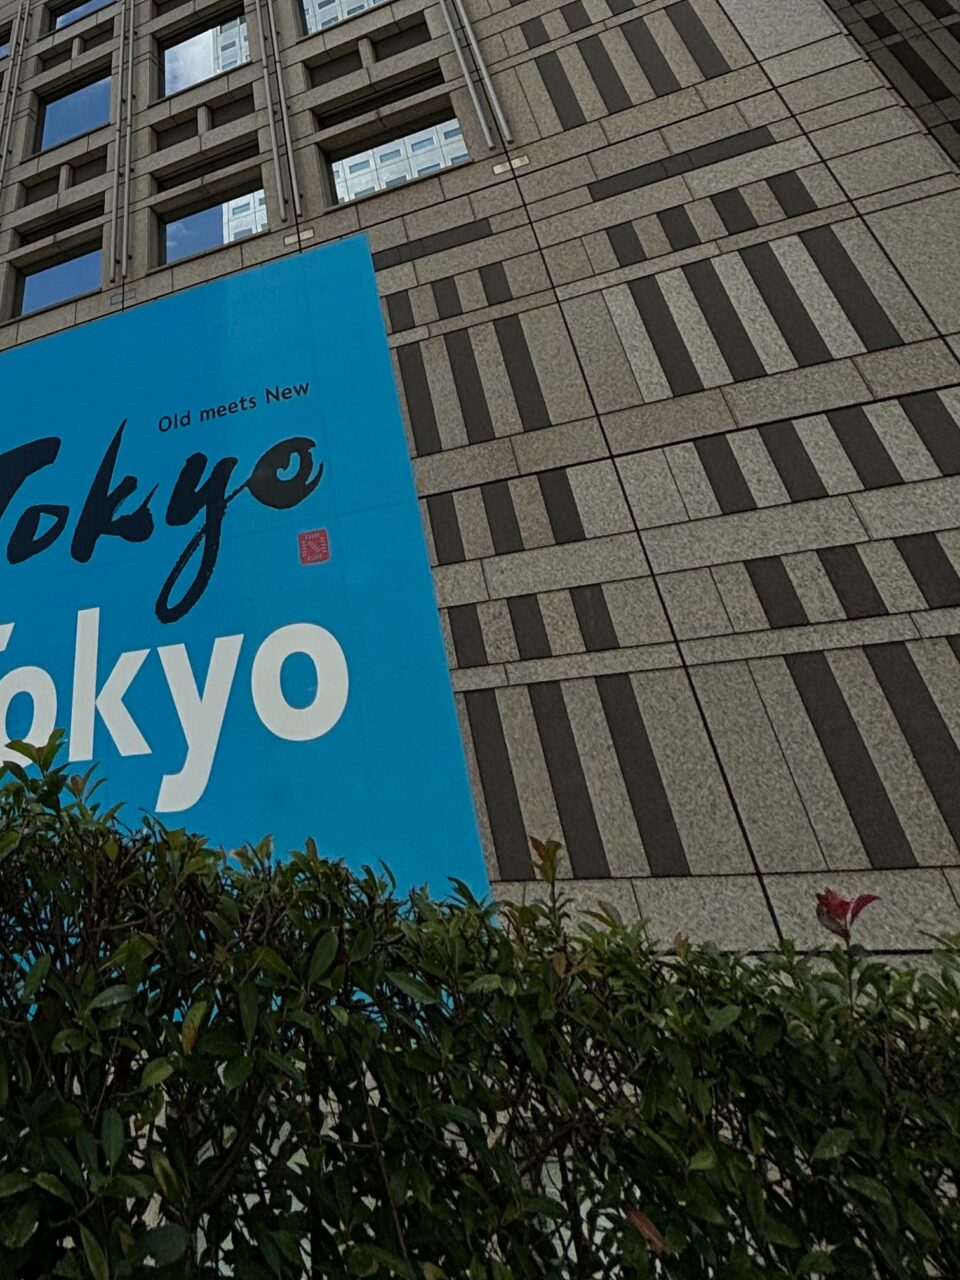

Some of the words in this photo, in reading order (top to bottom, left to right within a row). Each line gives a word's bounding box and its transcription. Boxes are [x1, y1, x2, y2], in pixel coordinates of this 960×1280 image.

[158, 410, 191, 433] Old
[199, 396, 257, 422] meets
[265, 382, 310, 405] New
